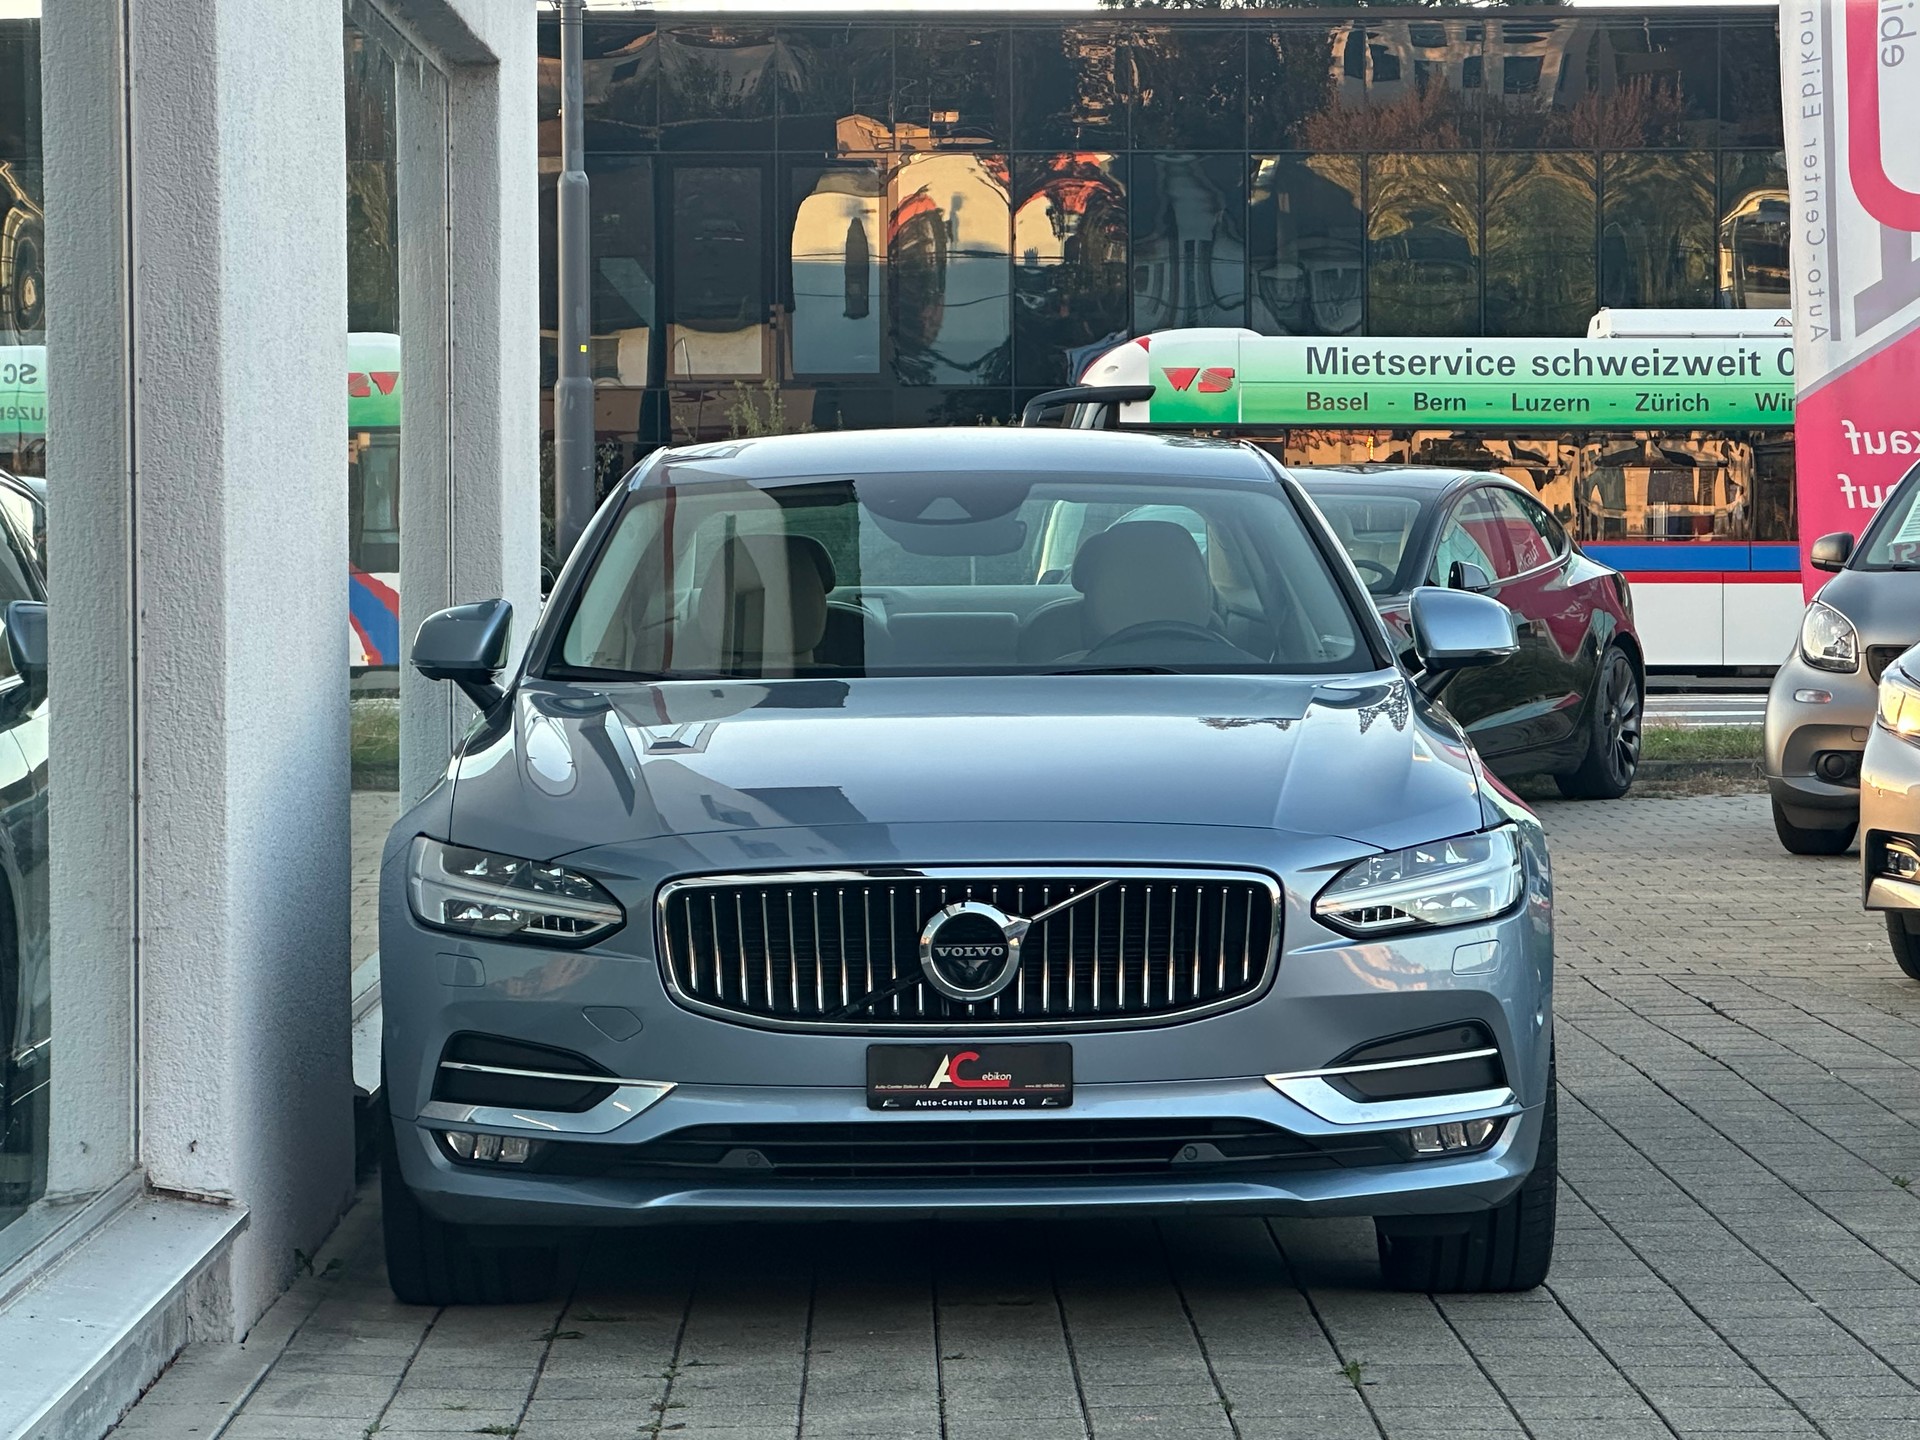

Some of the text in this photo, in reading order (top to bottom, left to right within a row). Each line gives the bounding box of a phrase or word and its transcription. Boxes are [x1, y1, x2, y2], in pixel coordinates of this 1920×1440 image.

[1306, 346, 1516, 376] Mietservice
[1531, 348, 1761, 376] schweizweit
[1306, 391, 1368, 411] Basel
[1414, 392, 1466, 411] Bern
[1512, 393, 1590, 412] Luzern
[1635, 393, 1710, 412] Zürich
[935, 947, 1004, 957] VOLVO
[982, 1072, 1012, 1081] ebikon
[977, 1098, 1008, 1106] Ebikon
[1012, 1098, 1026, 1106] AG
